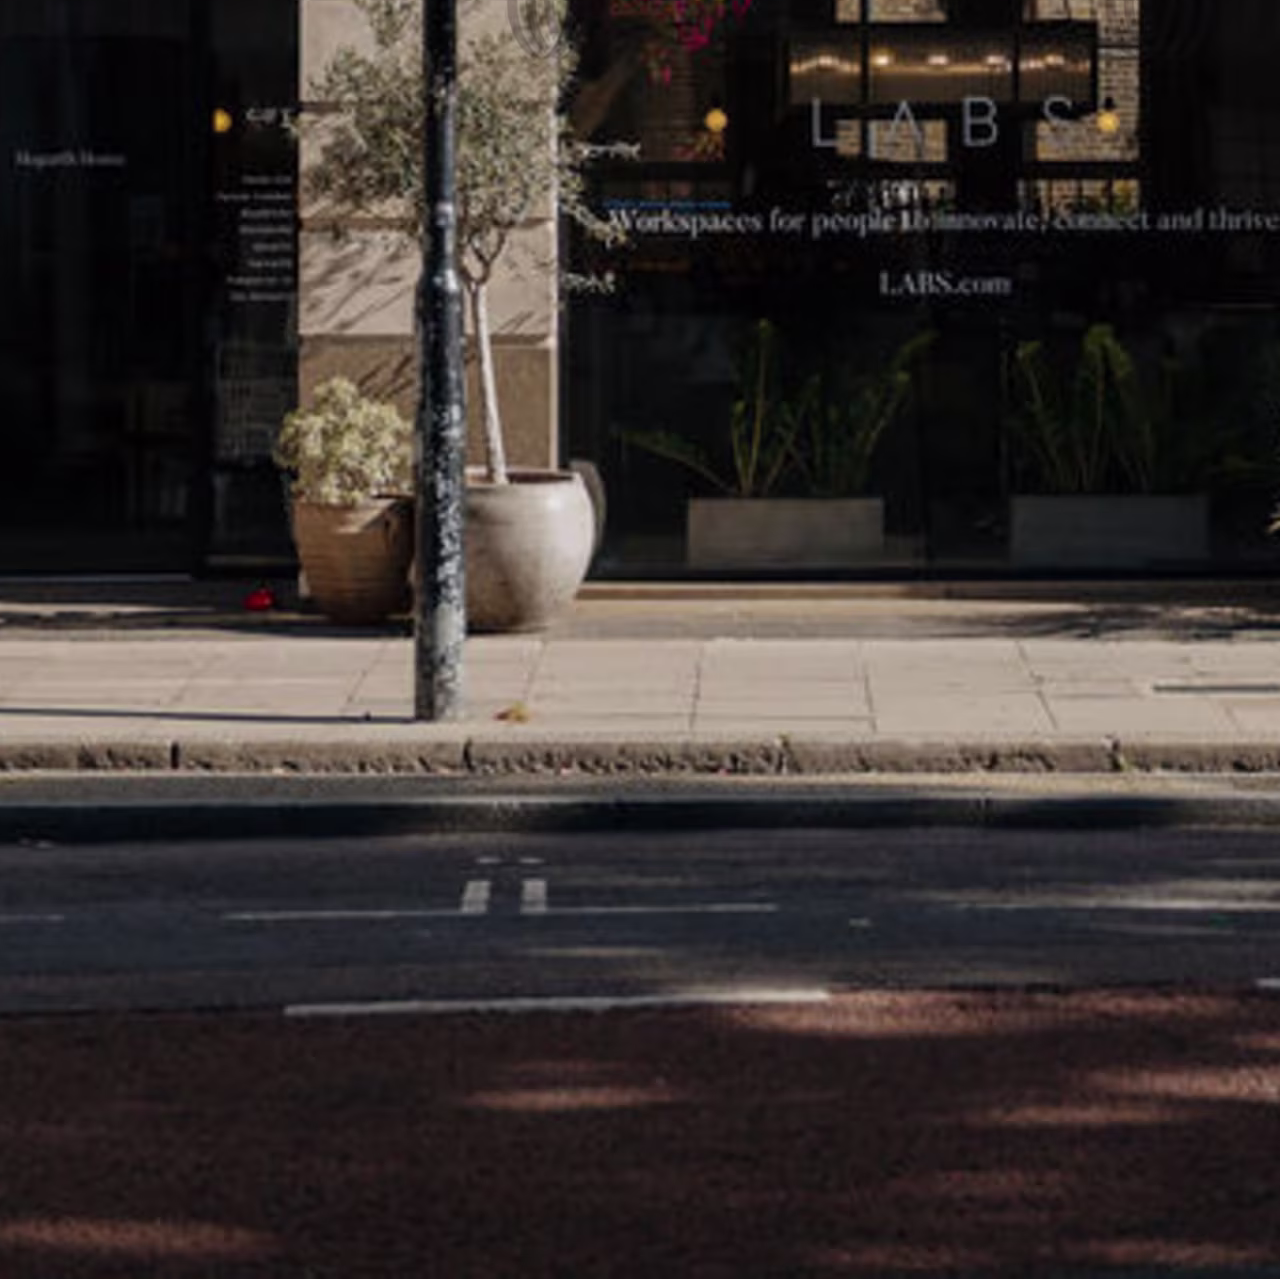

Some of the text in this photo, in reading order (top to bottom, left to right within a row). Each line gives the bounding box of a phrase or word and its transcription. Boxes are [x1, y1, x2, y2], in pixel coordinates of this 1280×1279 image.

[811, 96, 1074, 148] LABS
[770, 206, 805, 232] for
[811, 208, 896, 239] people
[880, 272, 1012, 295] LABS.com
